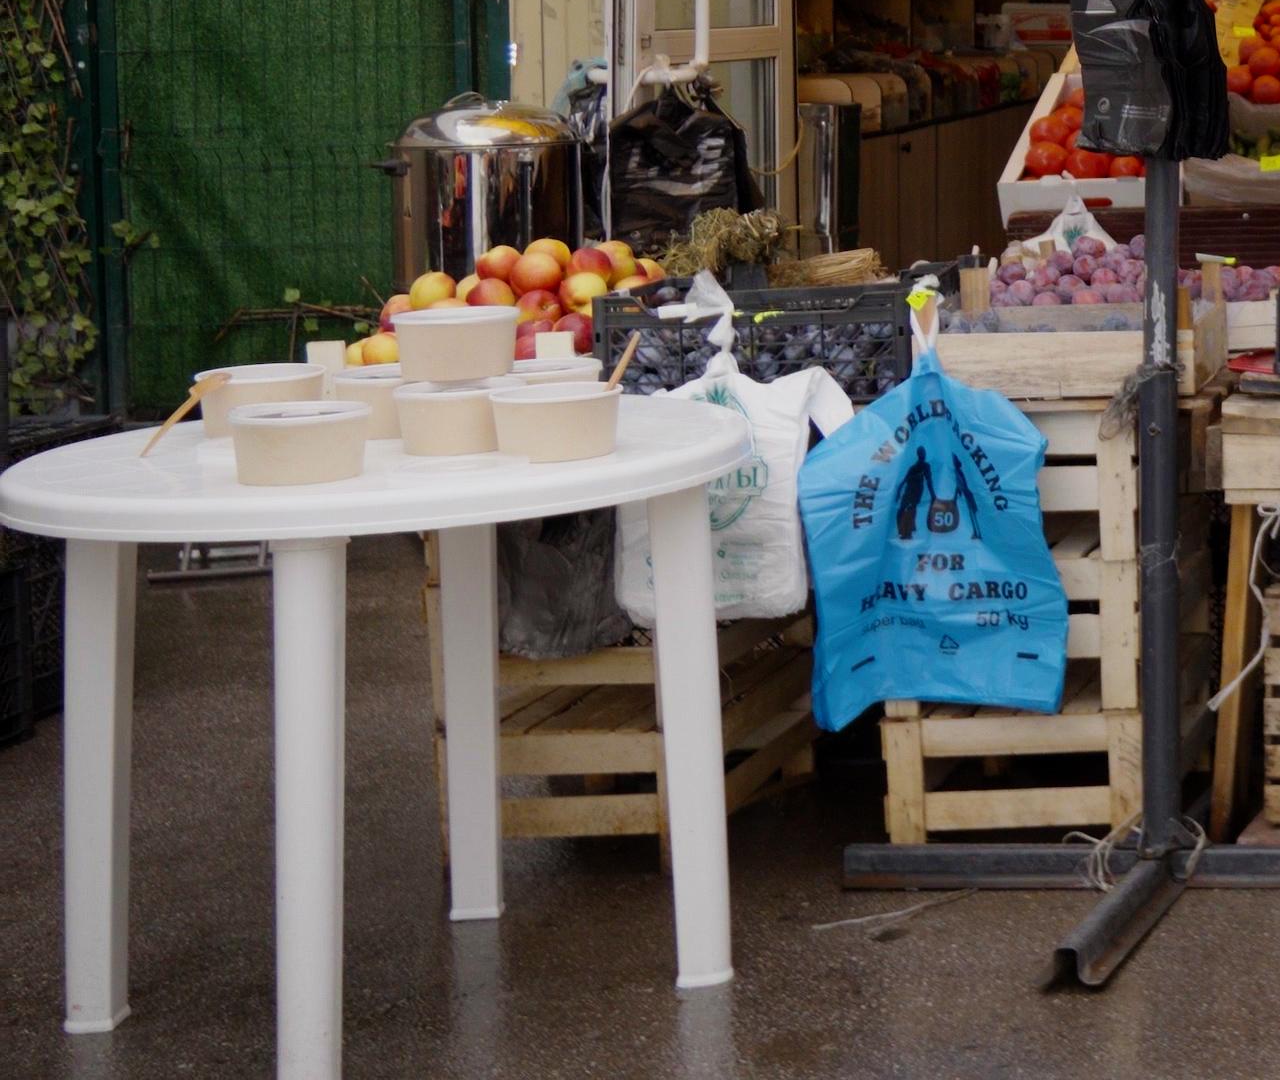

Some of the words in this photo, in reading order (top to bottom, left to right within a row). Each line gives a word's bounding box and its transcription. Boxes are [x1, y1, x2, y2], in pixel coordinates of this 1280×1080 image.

[852, 474, 881, 530] THE
[934, 511, 954, 527] 50
[915, 553, 966, 572] FOR
[948, 580, 1029, 601] CARGO
[975, 610, 1000, 628] 50
[1005, 609, 1029, 631] kg
